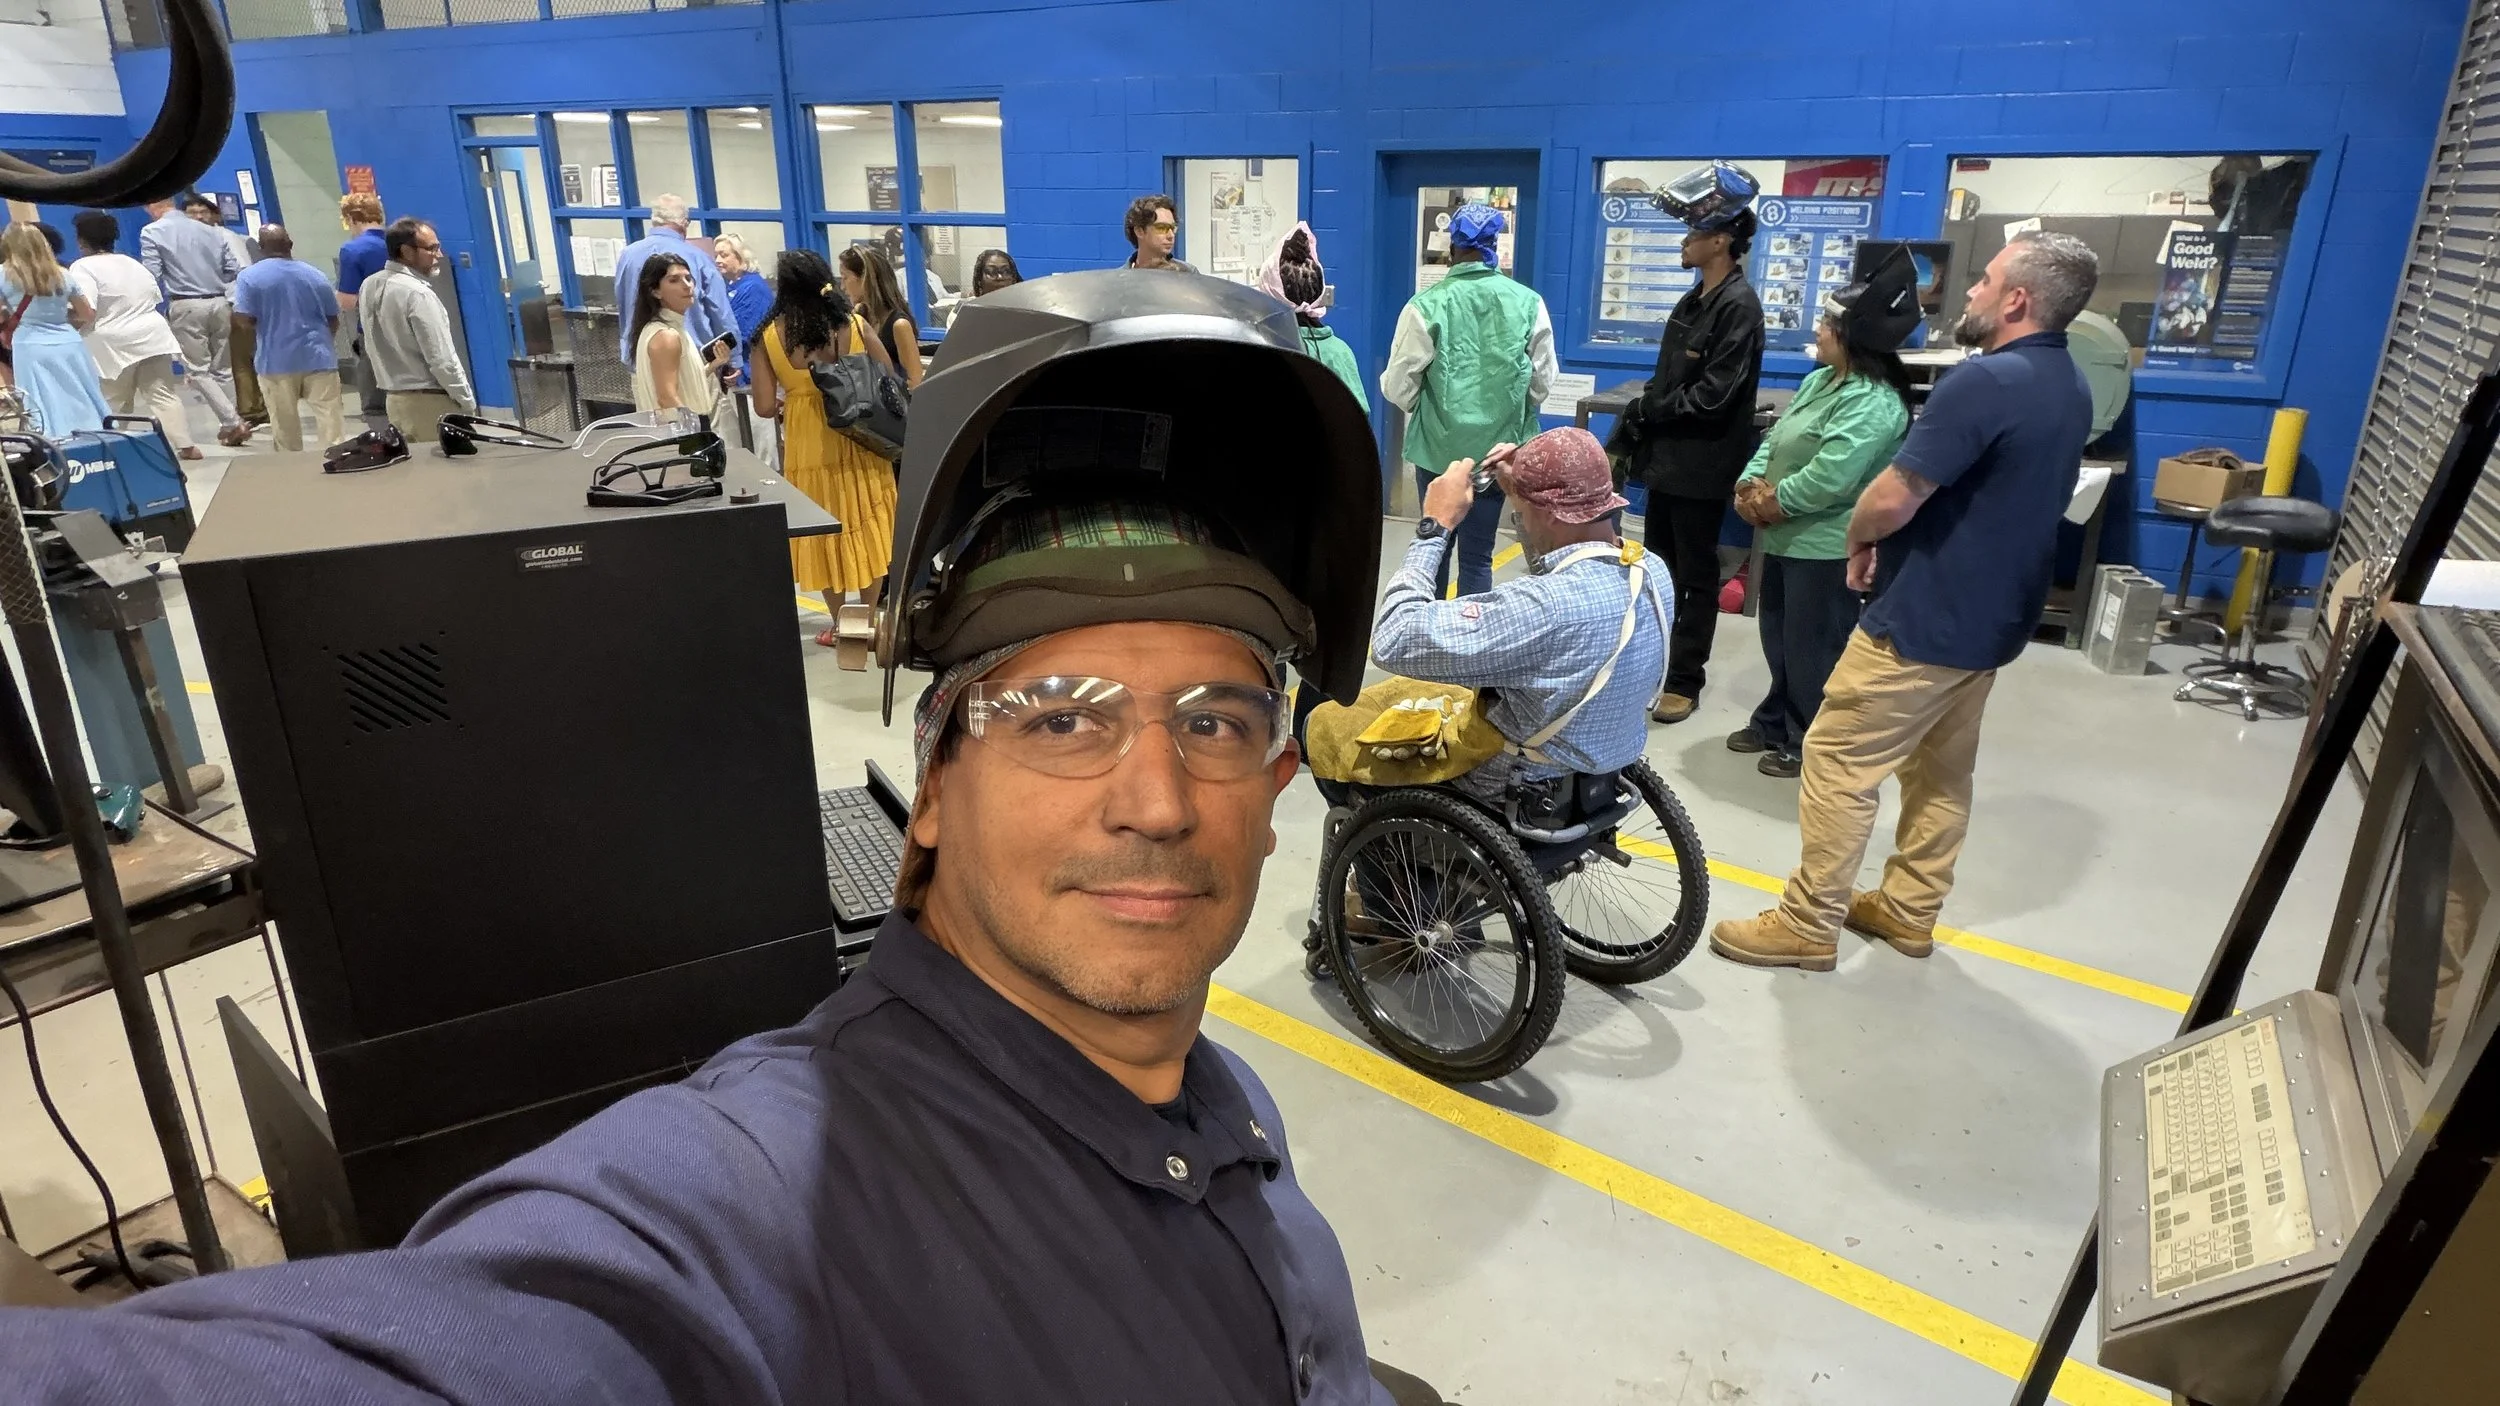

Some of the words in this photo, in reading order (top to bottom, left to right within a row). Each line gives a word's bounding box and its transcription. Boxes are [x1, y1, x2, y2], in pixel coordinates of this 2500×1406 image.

[1608, 202, 1620, 217] 5
[1766, 205, 1779, 221] 8
[1790, 206, 1821, 214] WELDING
[1822, 206, 1860, 215] POSITIONS
[2176, 234, 2193, 242] What
[2173, 242, 2215, 255] Good
[2171, 256, 2218, 269] Weld?
[84, 460, 116, 474] Miller
[531, 545, 583, 559] GLOBAL
